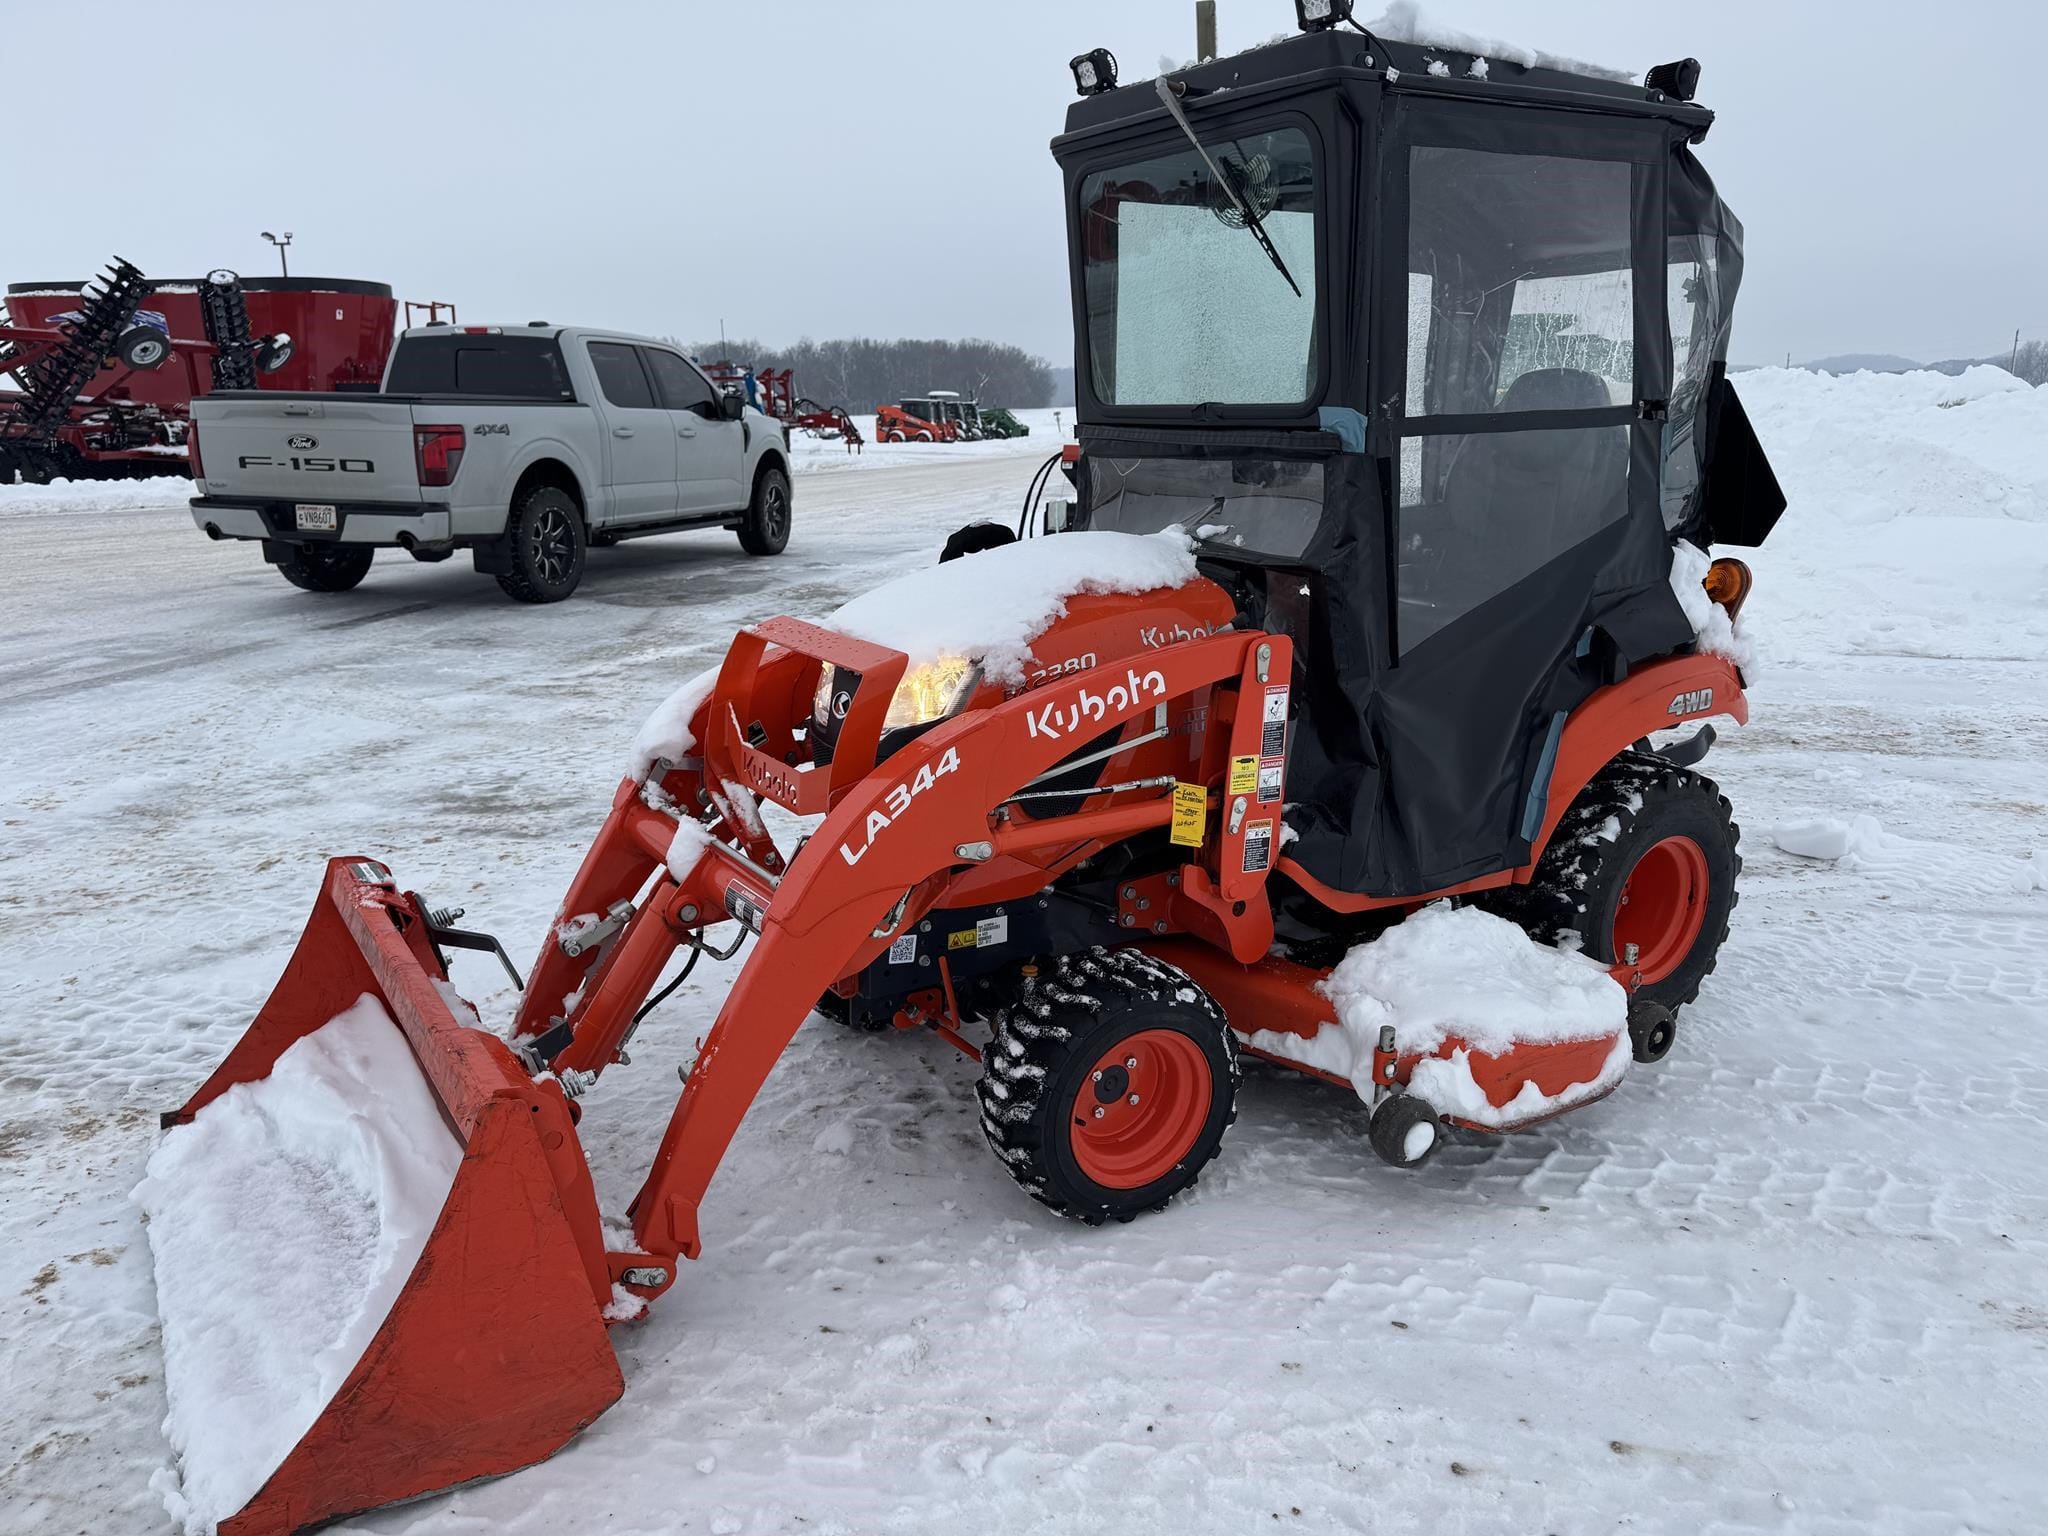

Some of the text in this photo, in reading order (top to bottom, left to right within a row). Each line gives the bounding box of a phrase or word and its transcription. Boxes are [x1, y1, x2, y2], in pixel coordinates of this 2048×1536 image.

[291, 436, 314, 449] Ford
[238, 456, 375, 473] F-150
[1140, 619, 1213, 648] Kubot
[1026, 669, 1166, 739] Kubota
[1667, 687, 1713, 716] 4WD
[743, 751, 797, 806] Kubota
[839, 746, 961, 866] LA344
